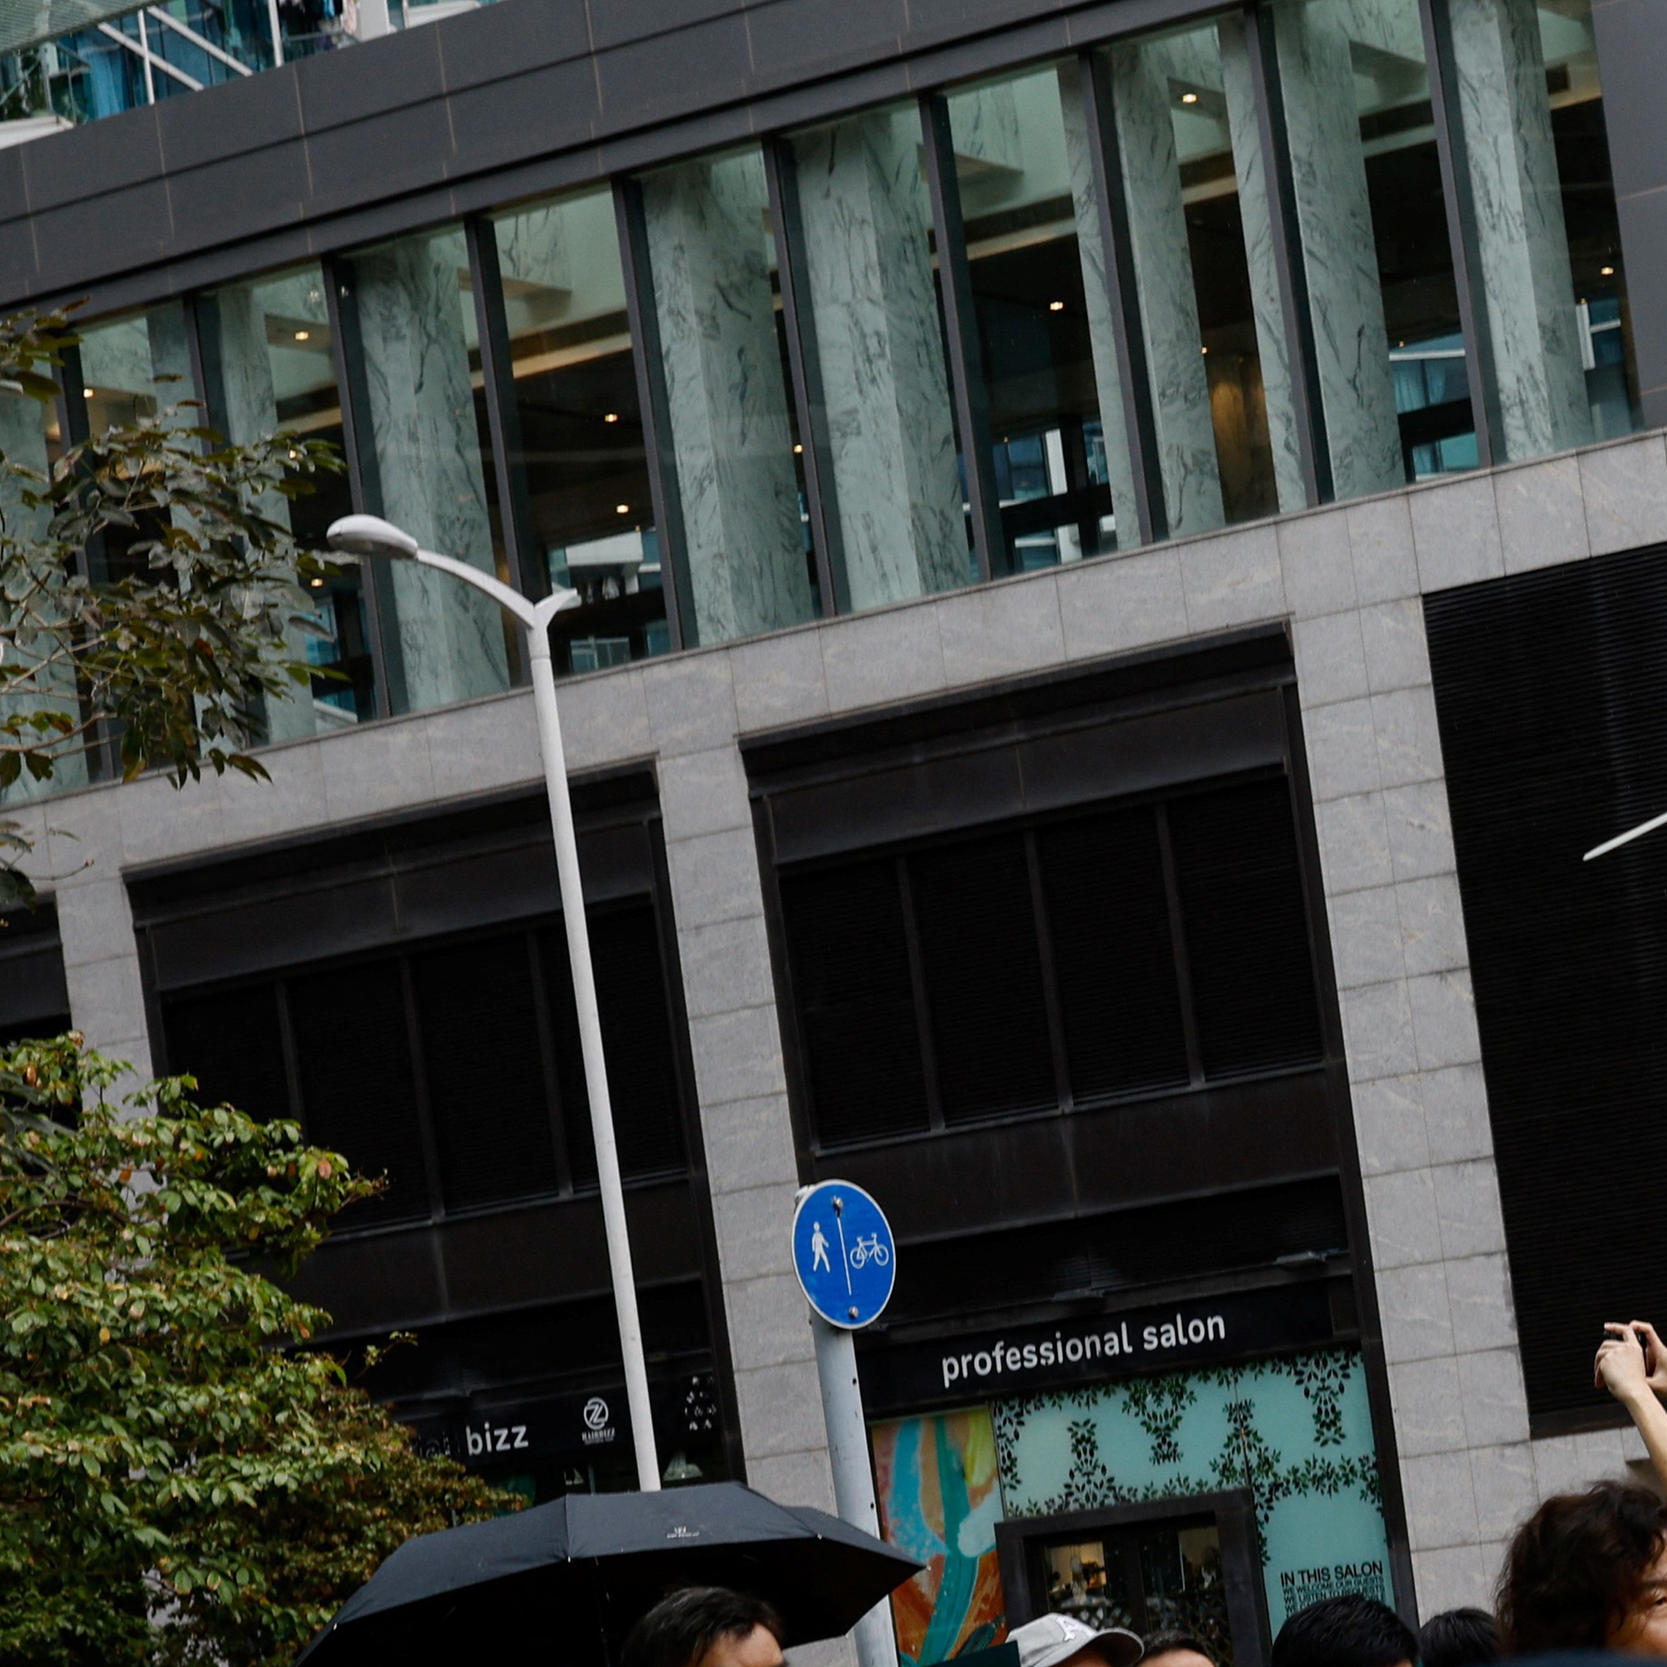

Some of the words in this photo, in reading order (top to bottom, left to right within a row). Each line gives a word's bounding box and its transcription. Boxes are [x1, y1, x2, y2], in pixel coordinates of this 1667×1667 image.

[942, 1321, 1133, 1389] professional
[1142, 1312, 1226, 1351] salon
[465, 1423, 529, 1456] bizz
[1280, 1571, 1295, 1587] IN
[1298, 1566, 1331, 1584] THIS
[1334, 1560, 1383, 1580] SALON
